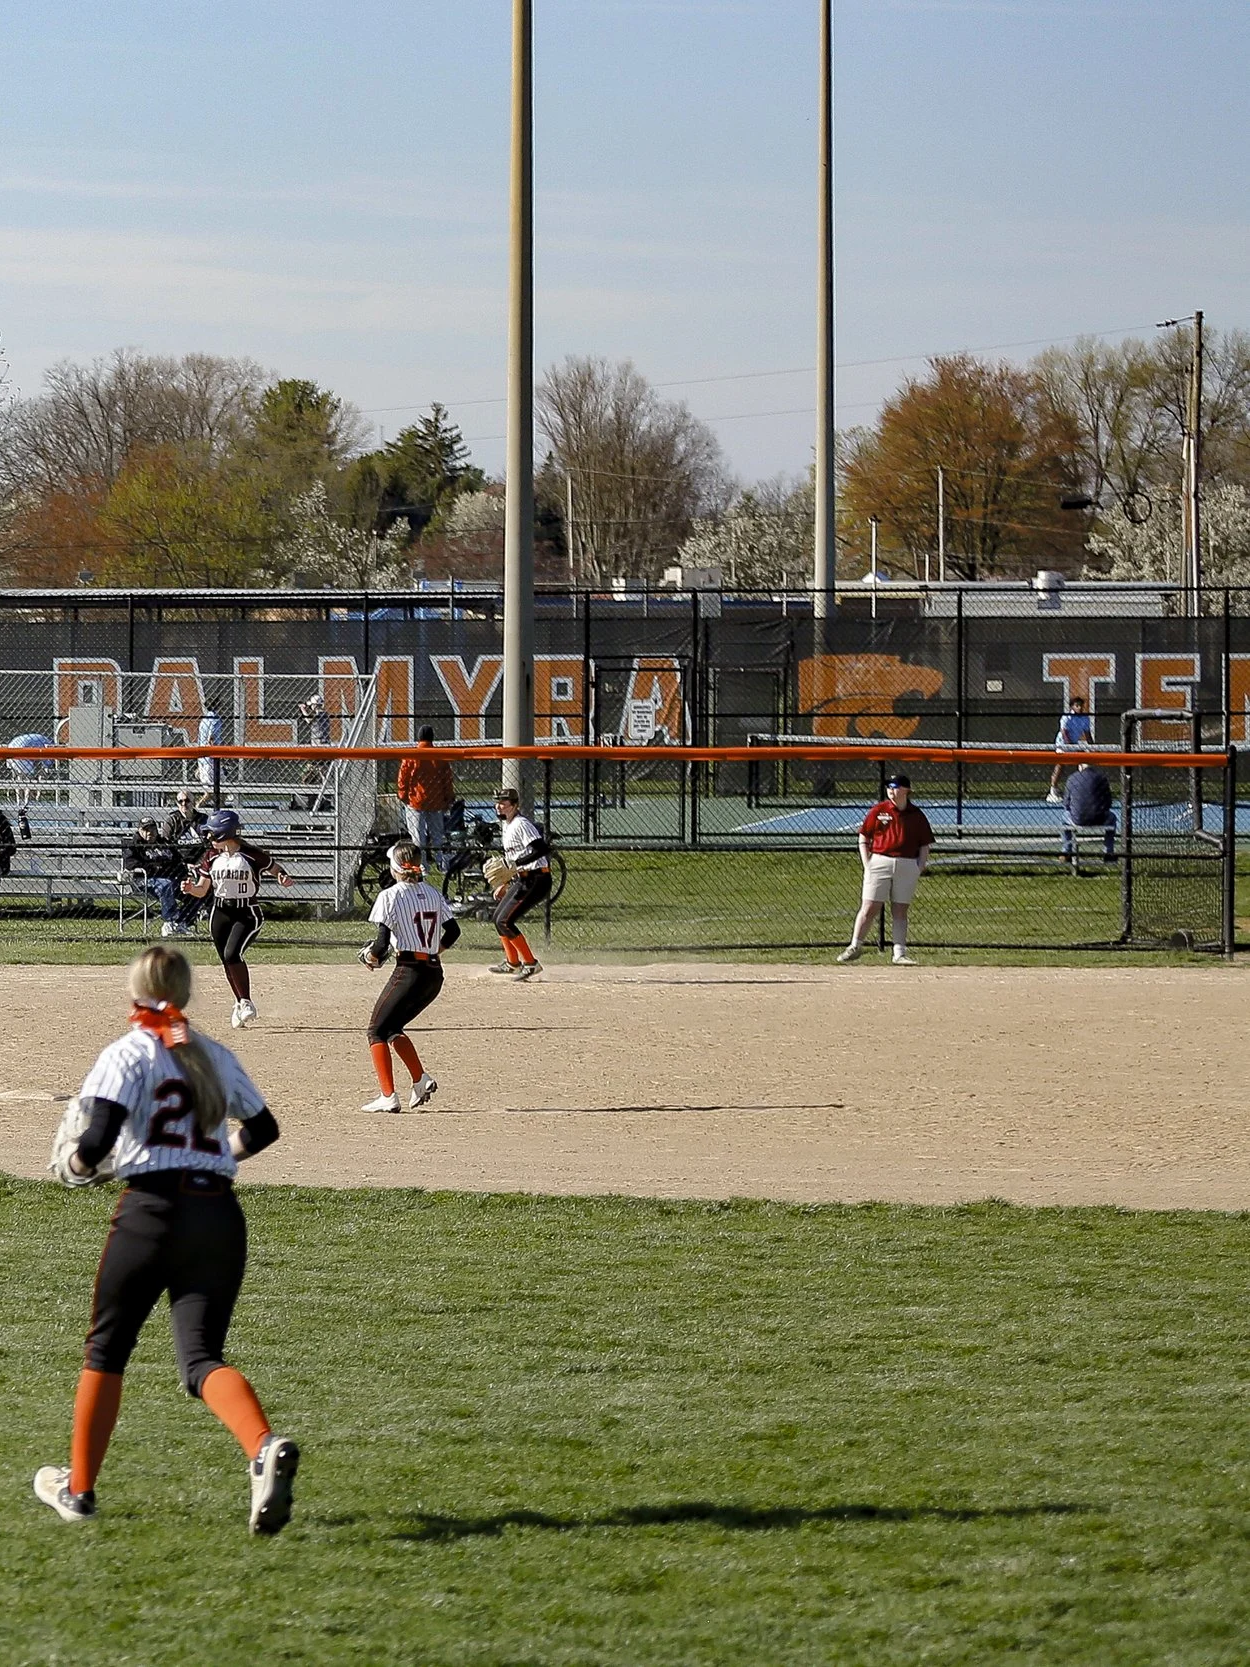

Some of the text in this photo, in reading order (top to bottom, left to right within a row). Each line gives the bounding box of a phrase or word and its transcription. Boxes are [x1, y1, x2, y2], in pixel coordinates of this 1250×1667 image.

[53, 655, 693, 746] PALMYRA
[238, 883, 248, 894] 10
[413, 911, 438, 948] 17
